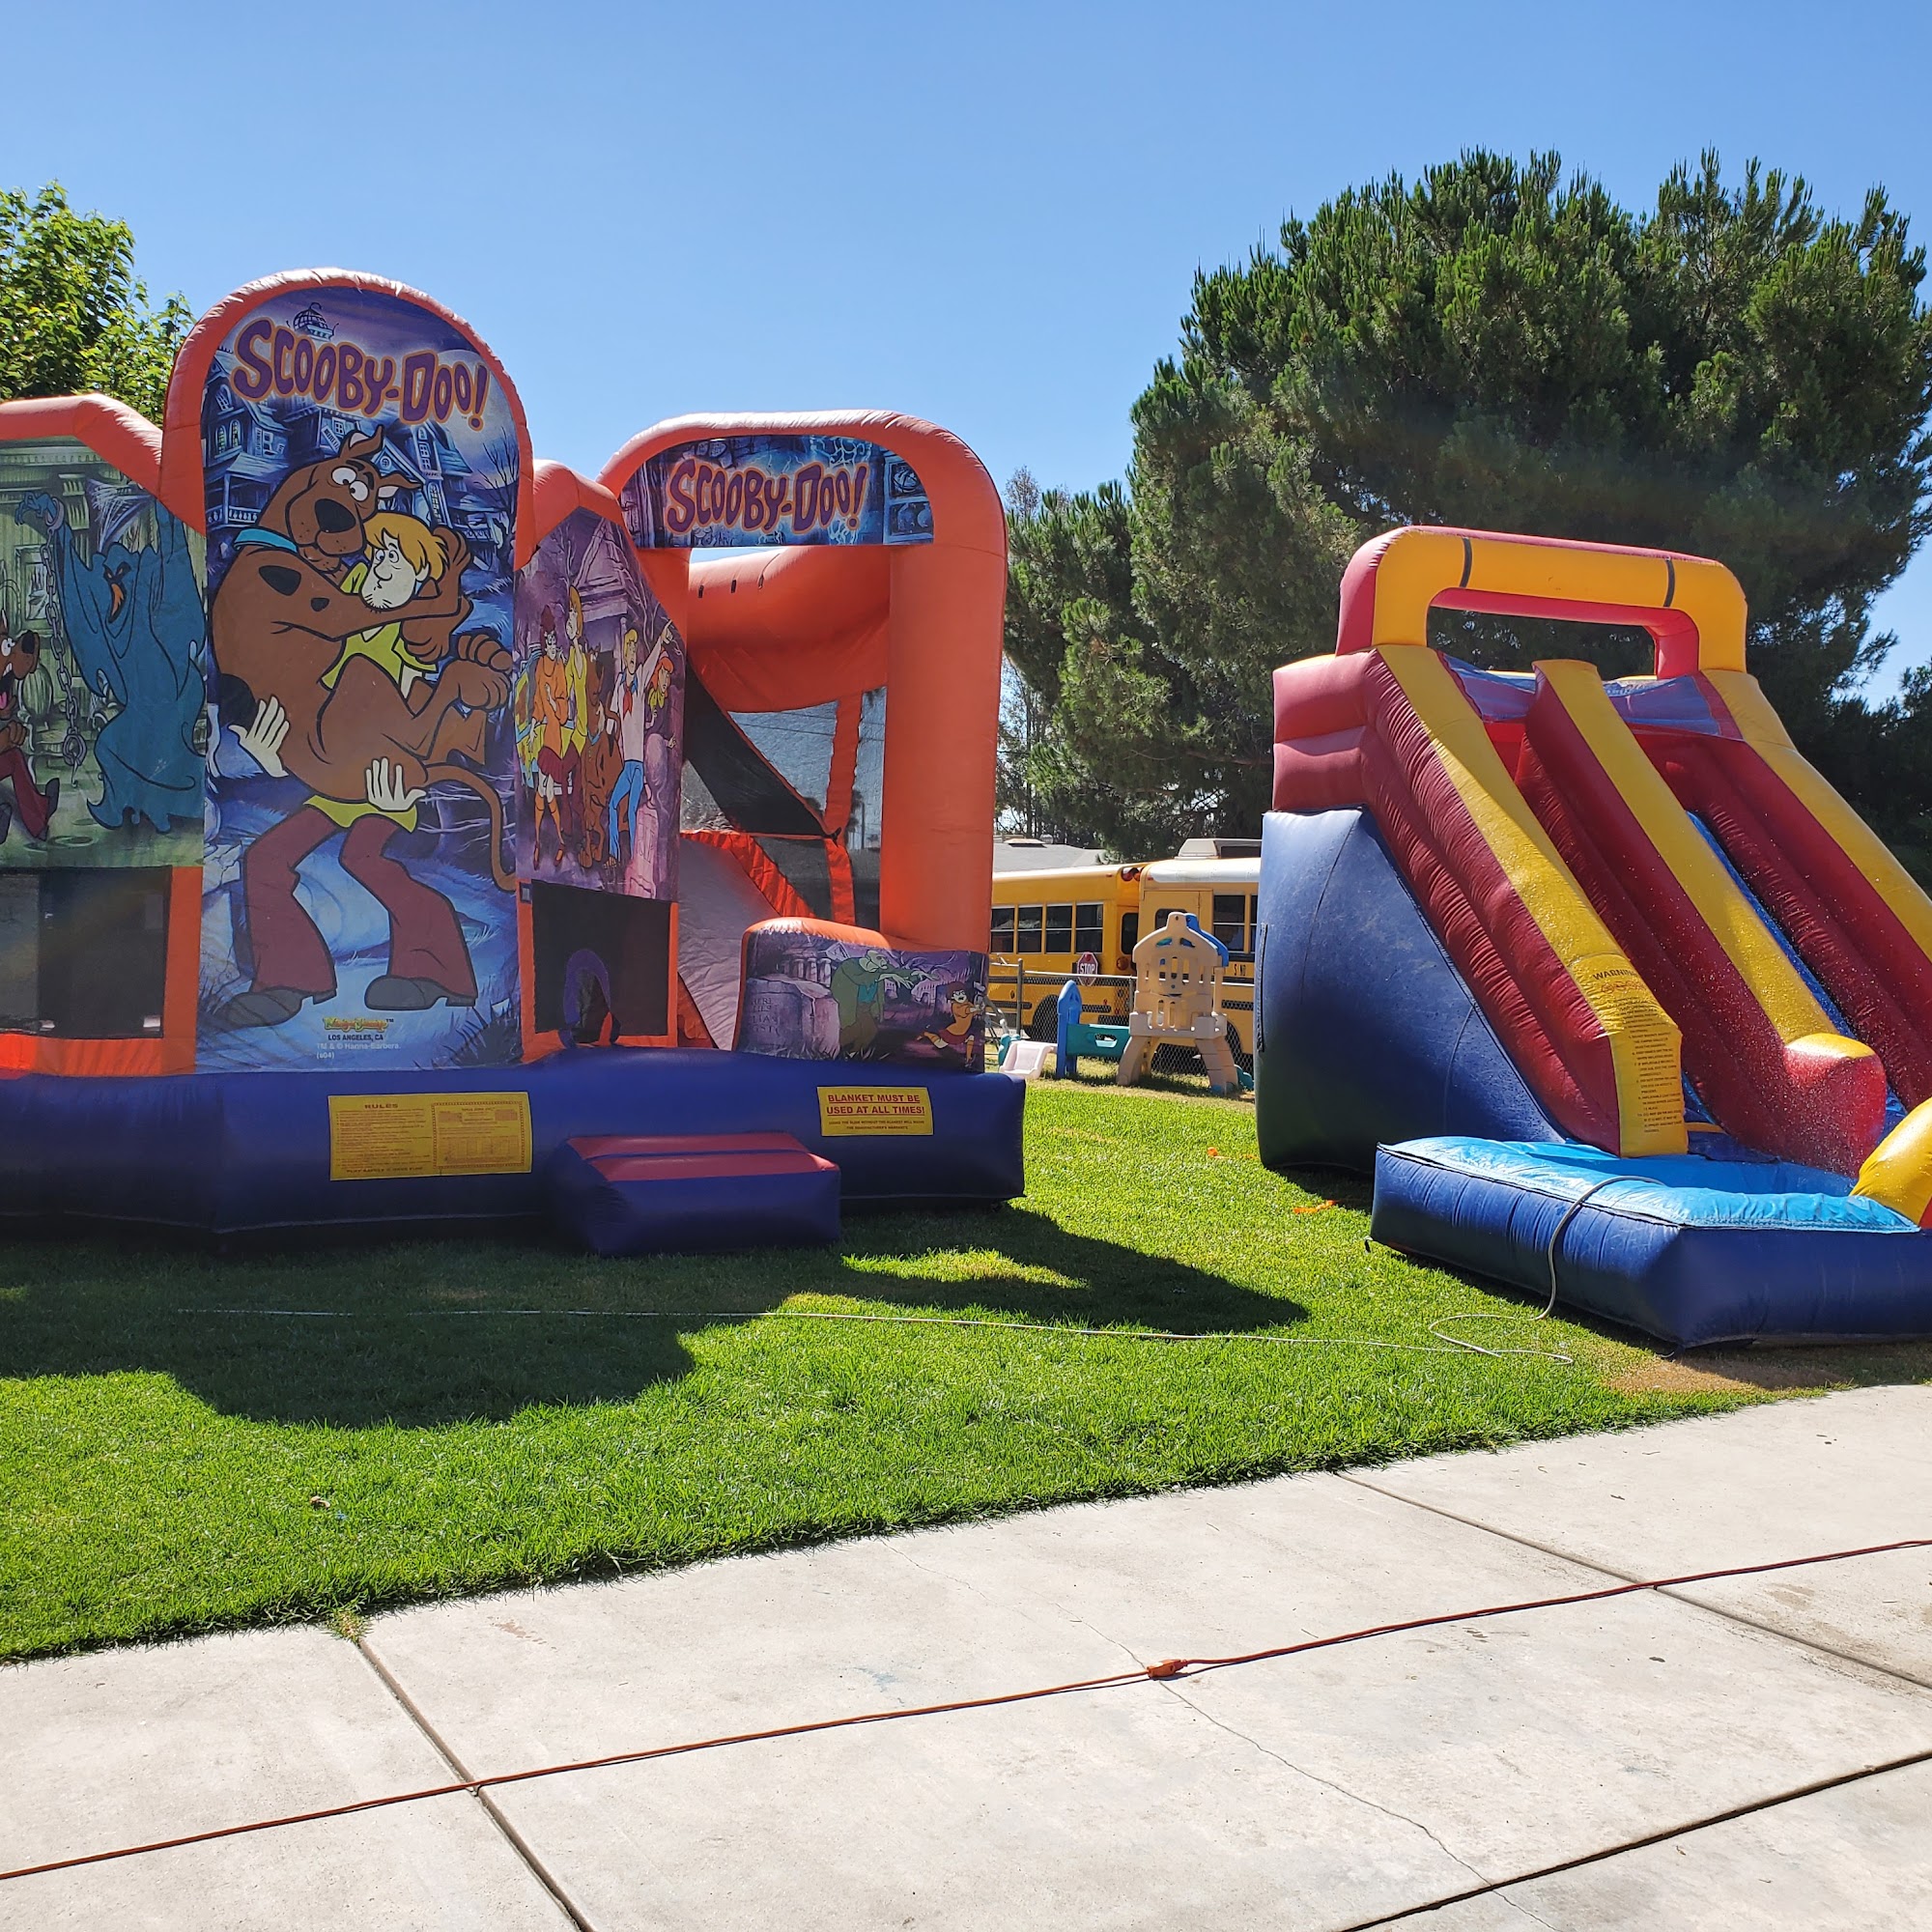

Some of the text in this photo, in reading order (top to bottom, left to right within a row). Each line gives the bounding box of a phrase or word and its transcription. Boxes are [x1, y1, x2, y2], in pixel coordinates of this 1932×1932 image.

[231, 317, 489, 431] SCOOBY-DOO!
[665, 457, 868, 534] SCOOBY-DOO!
[1080, 963, 1095, 975] STOP
[342, 1034, 374, 1042] ANGELES,
